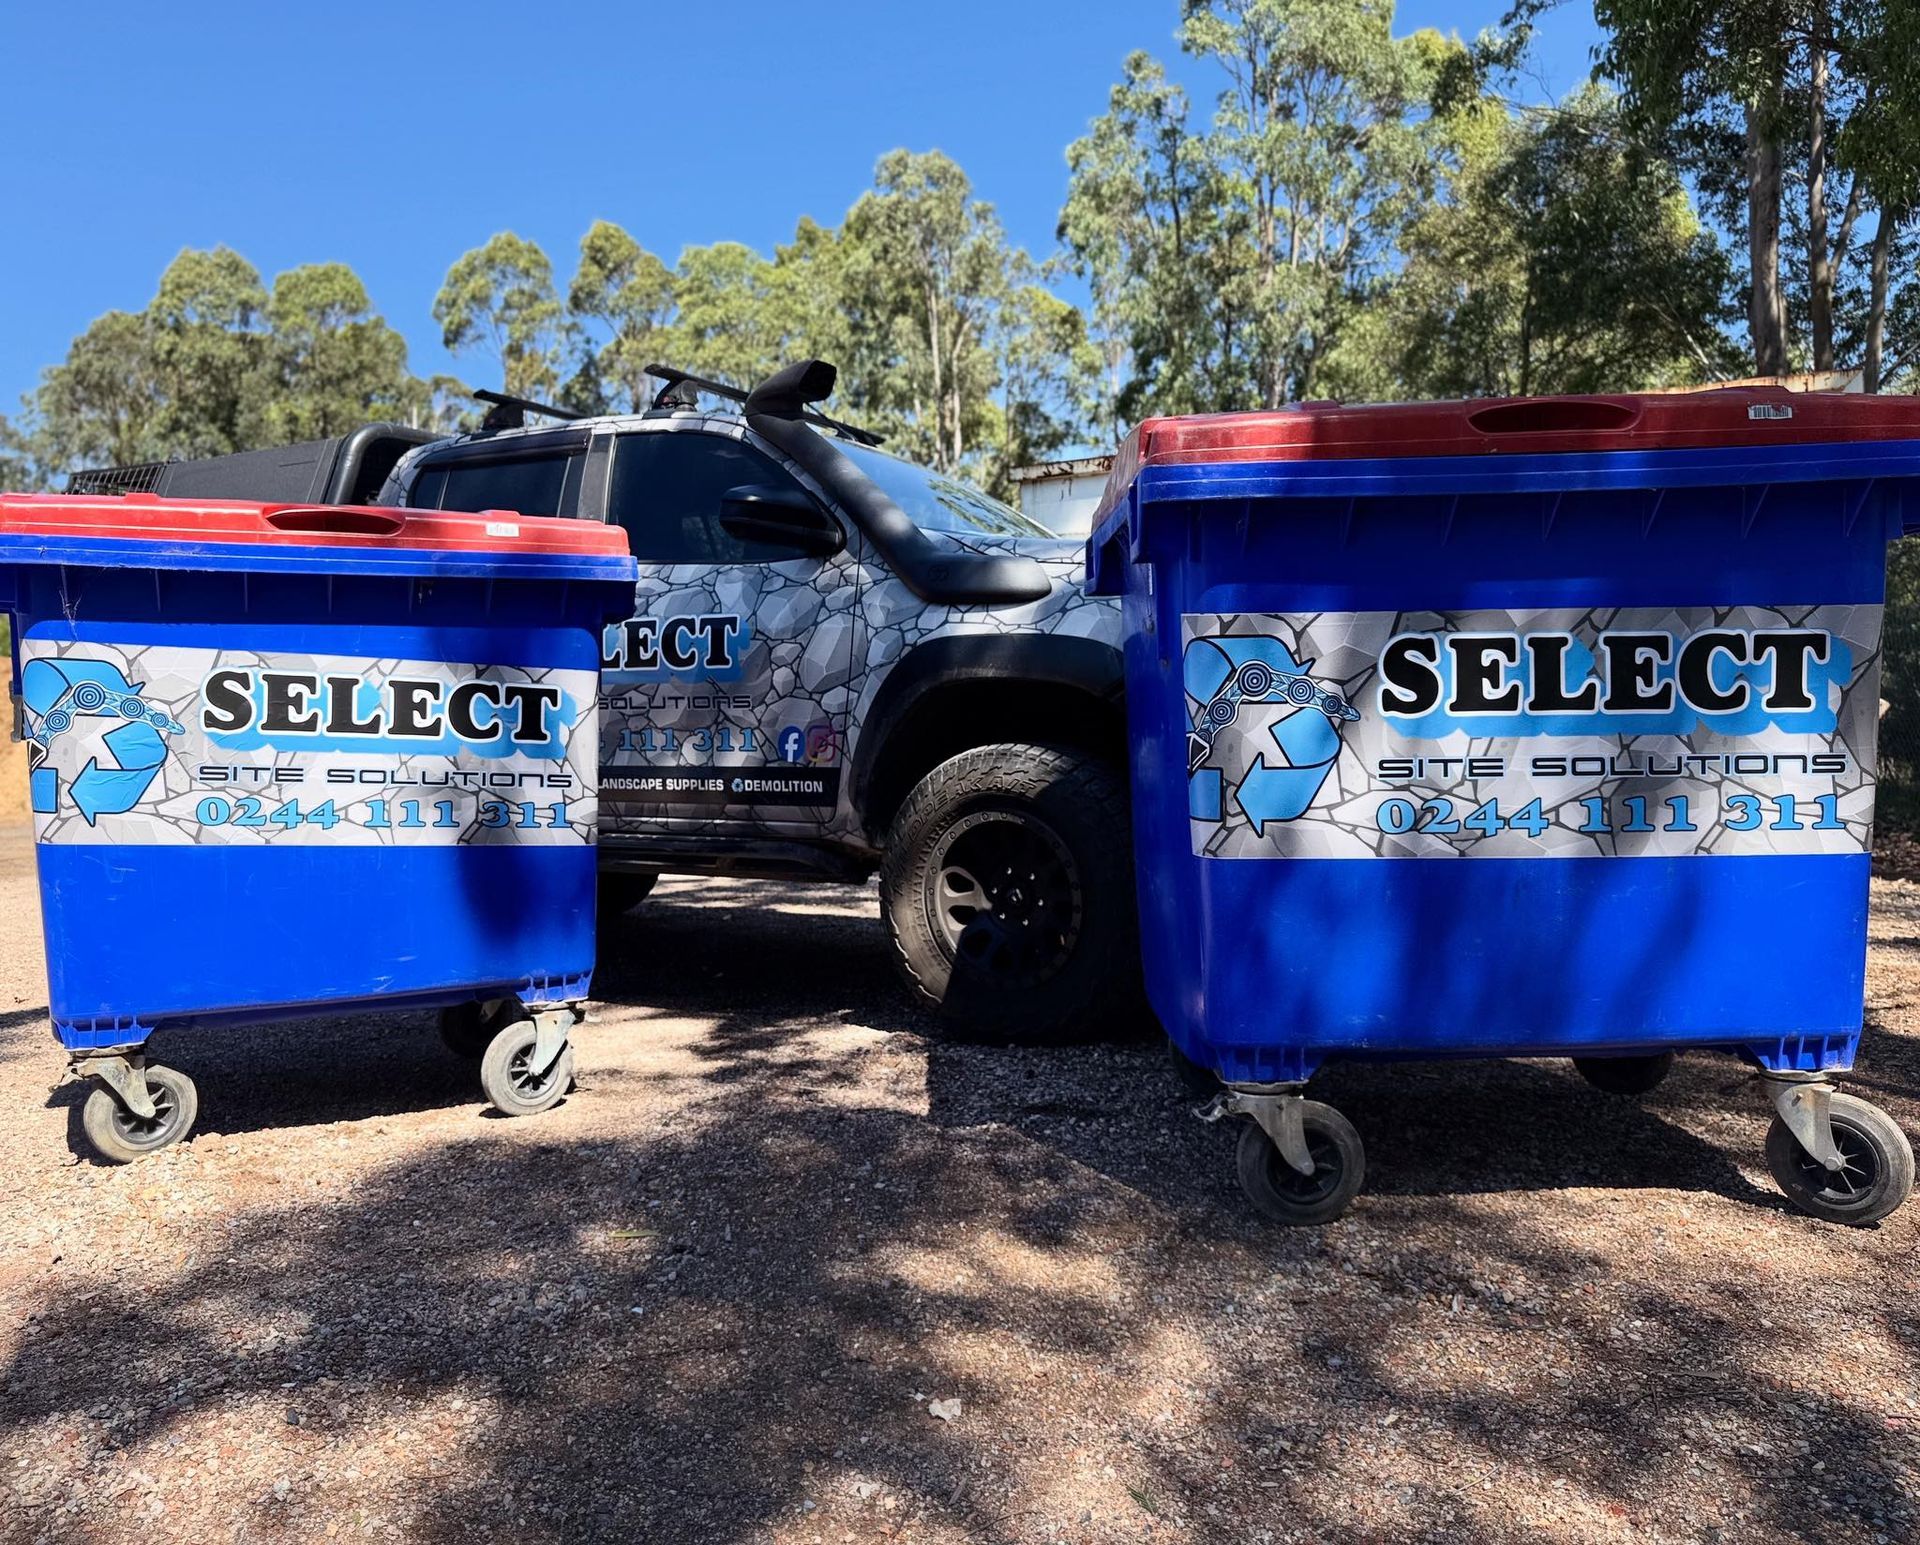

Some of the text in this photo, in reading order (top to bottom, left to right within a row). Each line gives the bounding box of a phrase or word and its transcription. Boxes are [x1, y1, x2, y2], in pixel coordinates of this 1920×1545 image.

[1380, 632, 1829, 717] SELECT
[201, 669, 560, 743] SELECT
[198, 765, 572, 788] SITE SOLUTIONS
[1378, 754, 1847, 778] SITE SOLUTIONS
[665, 779, 724, 792] SUPPLIES
[744, 780, 823, 793] DEMOLITION
[195, 797, 572, 830] 0244 111 311
[1376, 793, 1847, 838] 0244 111 311
